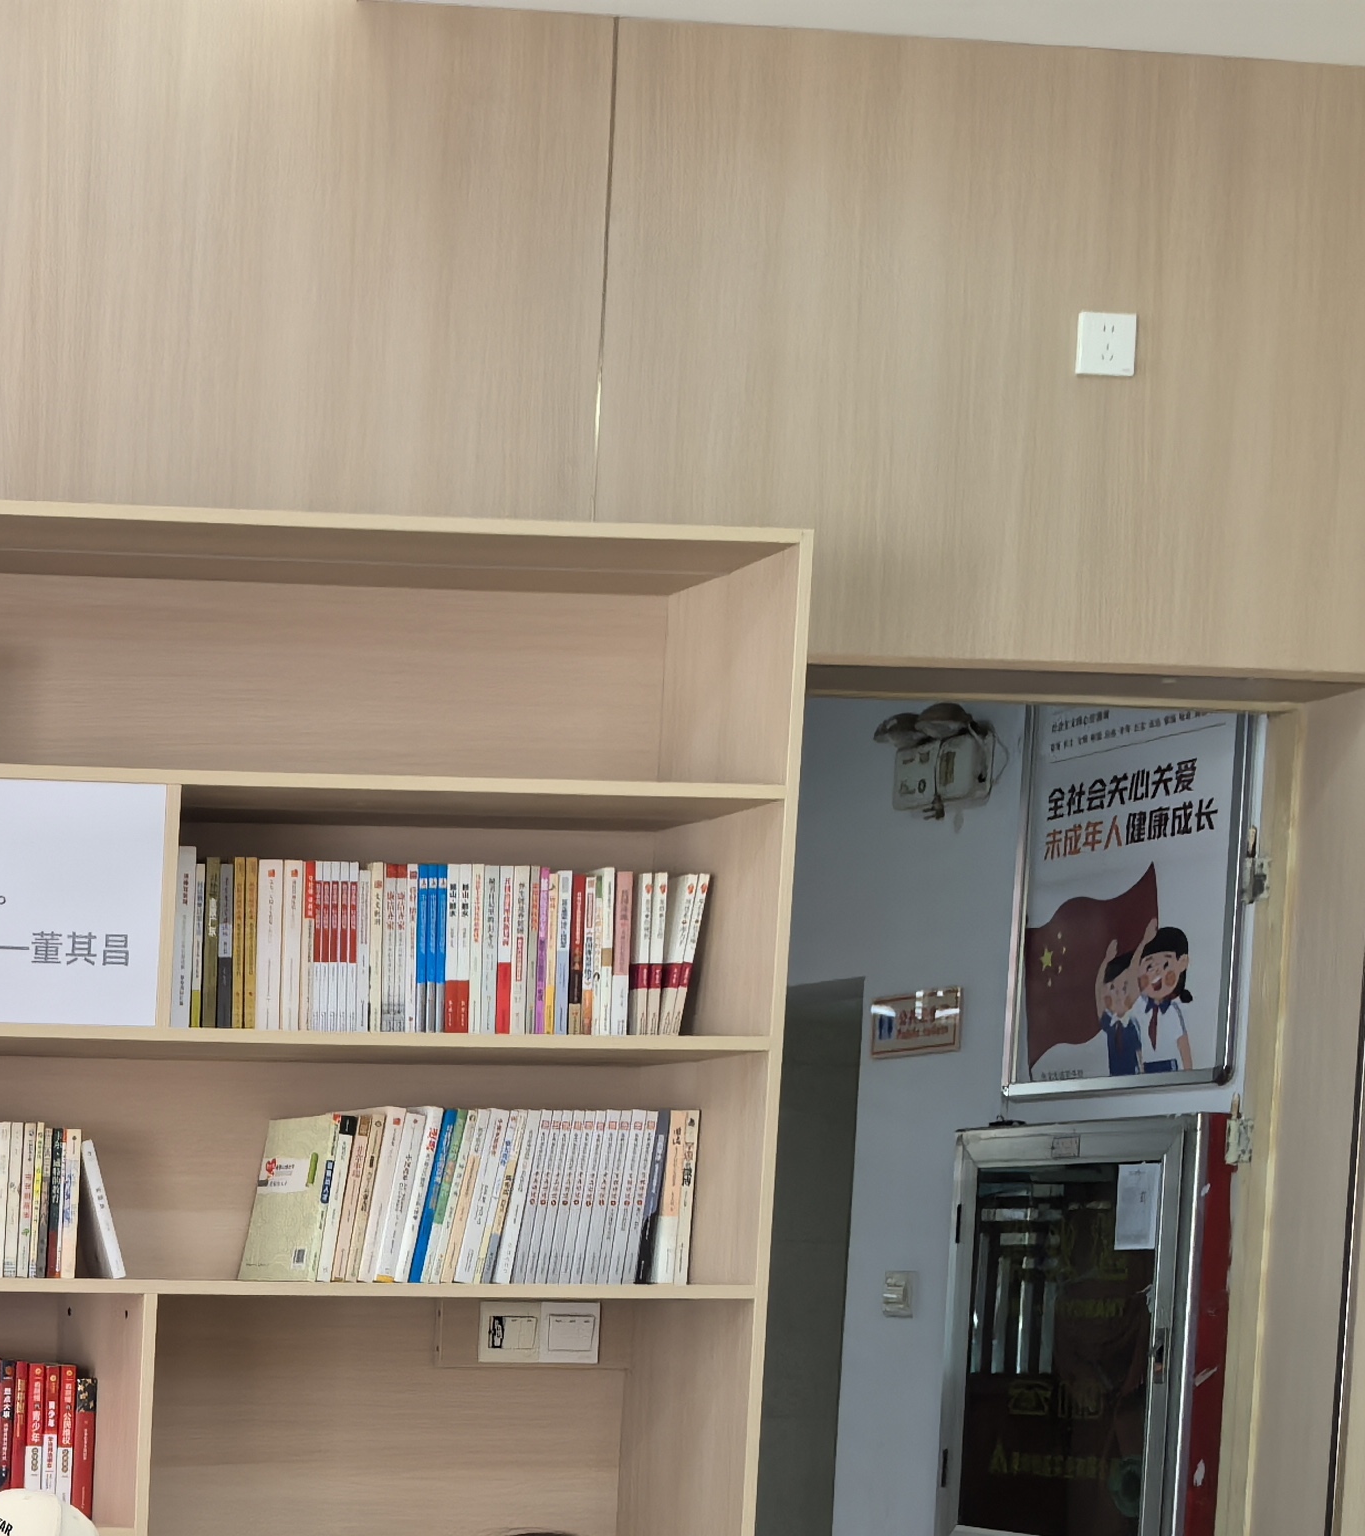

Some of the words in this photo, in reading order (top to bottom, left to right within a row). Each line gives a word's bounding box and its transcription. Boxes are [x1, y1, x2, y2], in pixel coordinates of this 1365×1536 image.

[1047, 758, 1197, 821] 全社会关心关爱
[1044, 797, 1218, 861] 未成年人健康成长
